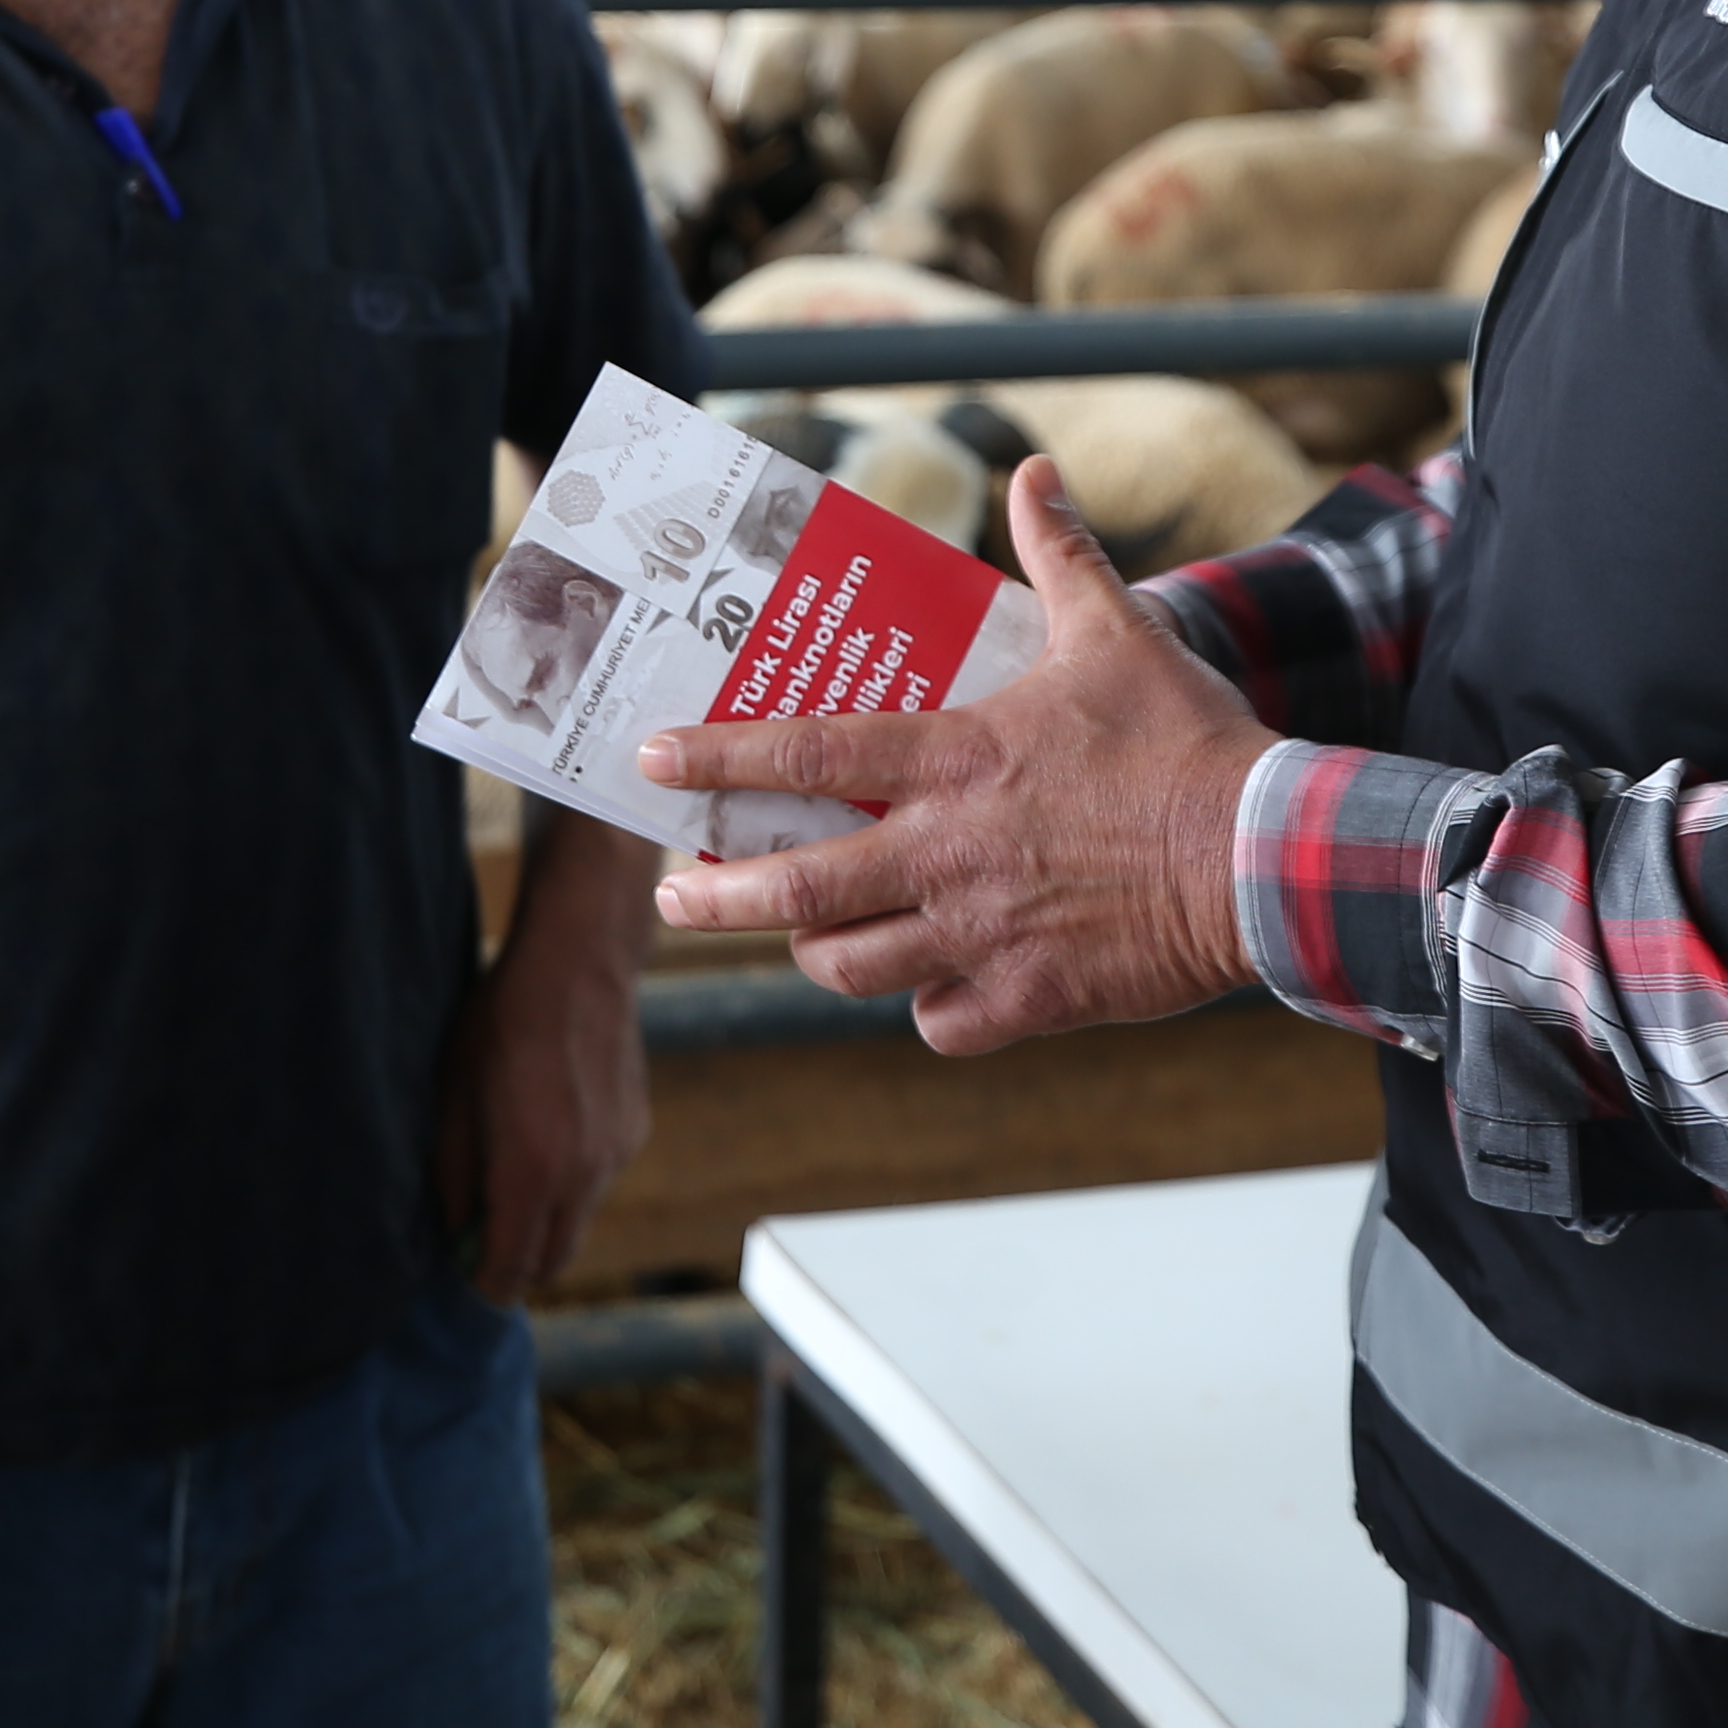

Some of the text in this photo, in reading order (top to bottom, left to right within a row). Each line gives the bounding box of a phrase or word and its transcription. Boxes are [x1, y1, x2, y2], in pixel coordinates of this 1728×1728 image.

[639, 518, 706, 583] 10
[702, 594, 754, 654] 20
[729, 574, 822, 716] Türk Lirası
[583, 624, 638, 715] CUMHURİYET
[852, 626, 914, 713] llikleri
[899, 671, 932, 713] eri
